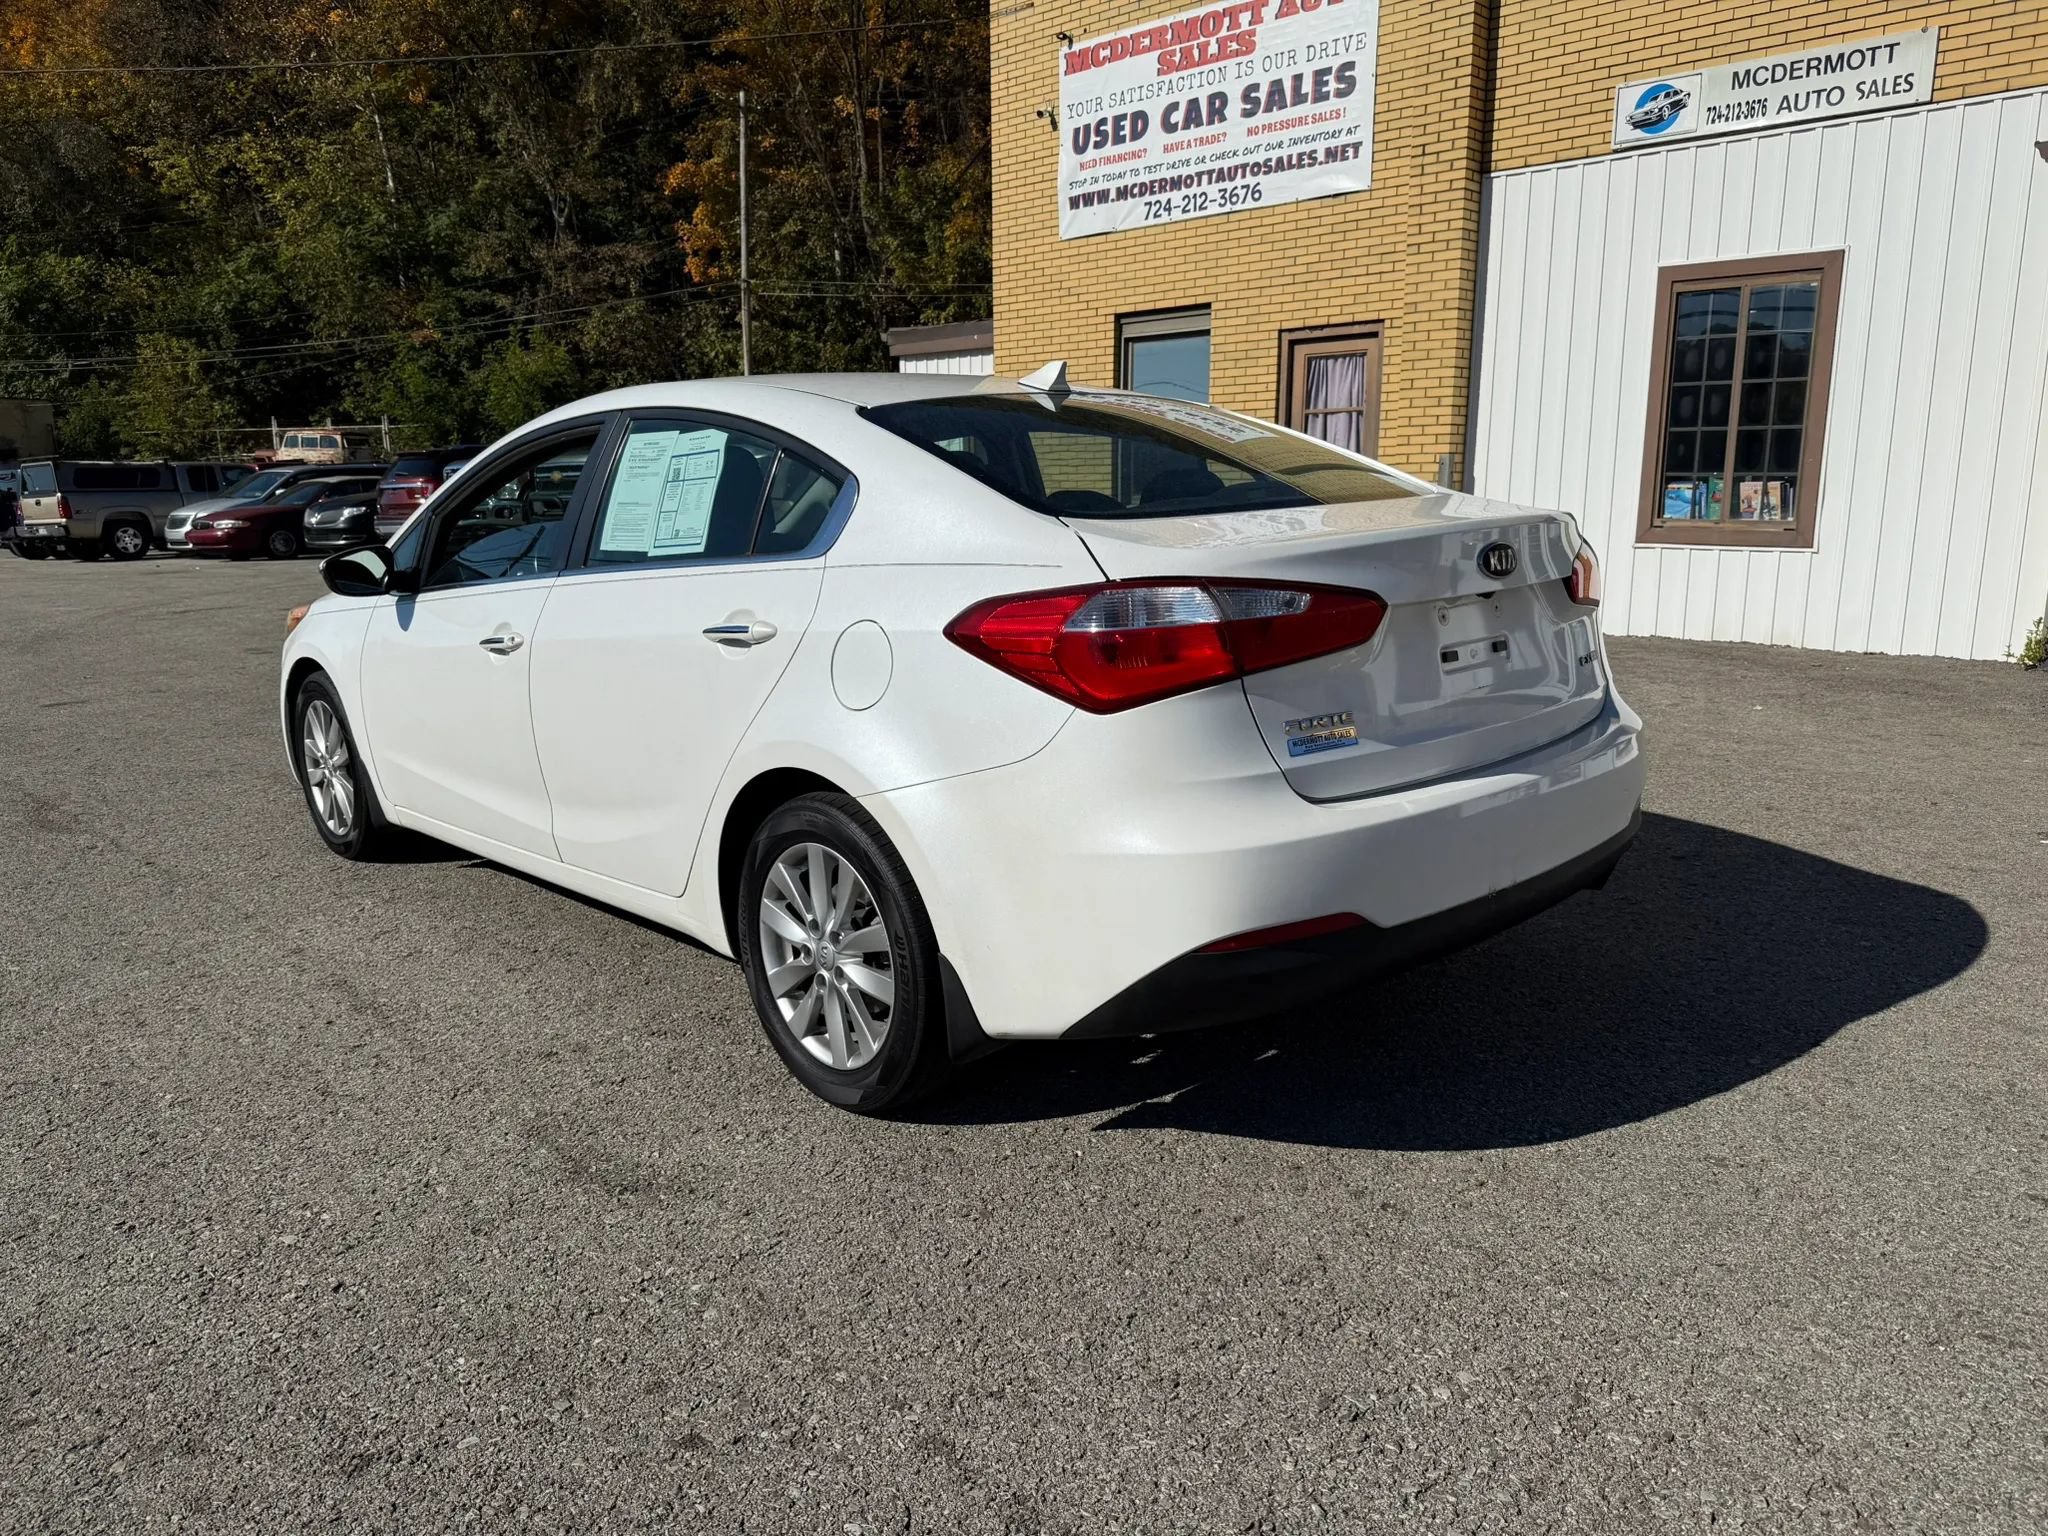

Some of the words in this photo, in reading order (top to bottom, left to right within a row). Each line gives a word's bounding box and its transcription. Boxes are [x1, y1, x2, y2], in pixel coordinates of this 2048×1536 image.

[1064, 0, 1269, 76] MCDERMOTT
[1157, 28, 1256, 76] SALES
[1067, 96, 1103, 119] YOUR
[1109, 66, 1227, 108] SATISFACTION
[1235, 60, 1254, 79] IS
[1262, 49, 1297, 72] OUR
[1306, 32, 1367, 62] DRIVE
[1731, 42, 1900, 90] MCDERMOTT
[1072, 110, 1149, 155] USED
[1160, 91, 1229, 134] CAR
[1240, 61, 1357, 118] SALES
[1706, 98, 1768, 125] 724-212-3676
[1776, 85, 1845, 115] AUTO
[1856, 73, 1914, 100] SALES
[1163, 140, 1185, 153] HAVE
[1185, 139, 1192, 149] A
[1193, 132, 1227, 147] TRADE?
[1247, 125, 1260, 137] NO
[1261, 115, 1310, 134] PRESSURE
[1068, 141, 1363, 210] WWW.MCDERMOTTAUTOSALES.NET
[1069, 178, 1087, 190] STOP
[1090, 175, 1100, 185] IN
[1102, 169, 1127, 182] TODAY
[1130, 166, 1140, 177] TO
[1143, 162, 1164, 174] TEST
[1166, 158, 1191, 171] DRIVE
[1194, 156, 1206, 165] OR
[1209, 149, 1239, 162] CHECK
[1242, 144, 1262, 156] OUT
[1265, 140, 1284, 152] OUR
[1288, 127, 1343, 146] INVENTORY
[1345, 125, 1361, 136] AT
[1080, 158, 1097, 171] NEED
[1099, 148, 1148, 166] FINANCING?
[1144, 182, 1262, 221] 724-212-3676
[1488, 549, 1516, 571] KIA
